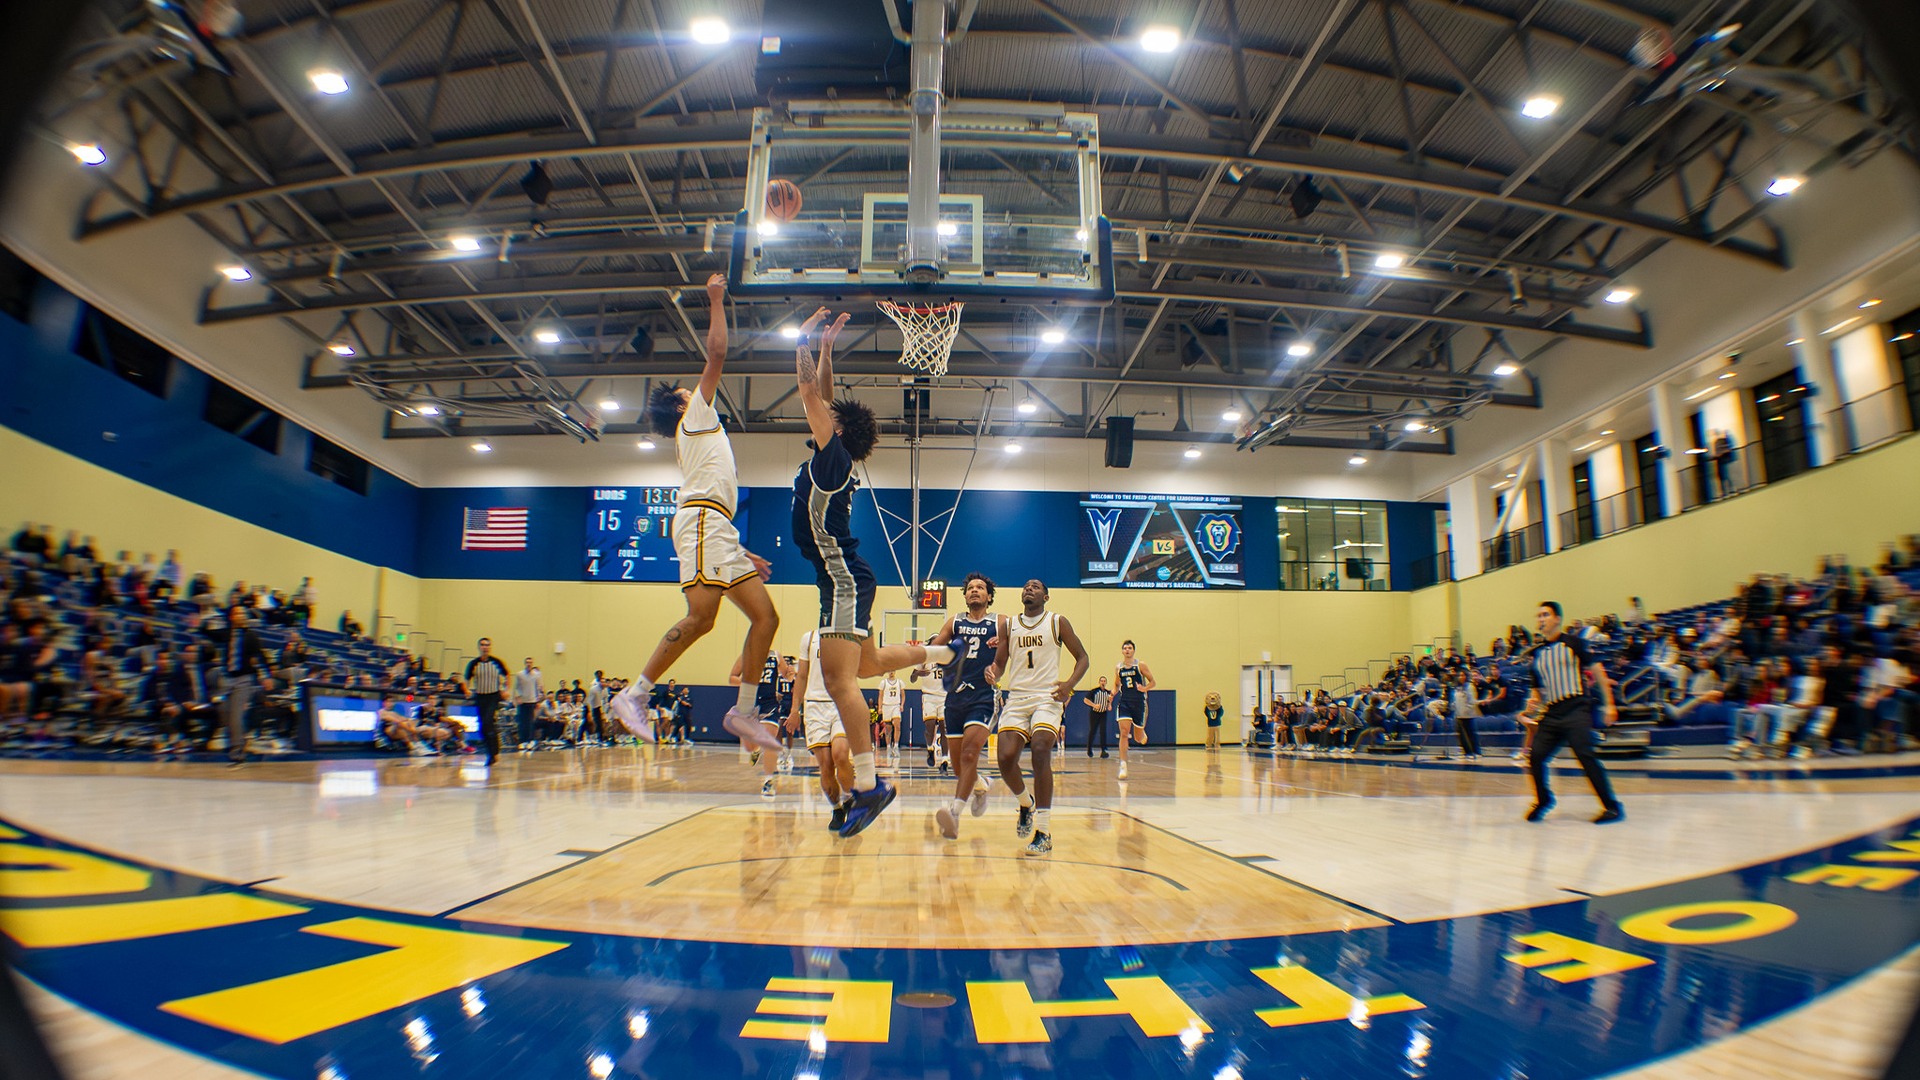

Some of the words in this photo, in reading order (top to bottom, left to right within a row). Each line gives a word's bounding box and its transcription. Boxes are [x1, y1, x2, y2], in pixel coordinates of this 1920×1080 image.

[594, 490, 627, 500] LIONS
[645, 488, 679, 504] 13:0
[648, 506, 676, 515] PERIO
[597, 510, 621, 531] 15
[660, 517, 669, 537] 1
[618, 549, 640, 558] FOULS
[1157, 541, 1172, 552] VS
[587, 559, 600, 576] 4
[621, 559, 635, 579] 2
[923, 581, 944, 590] 13:07
[922, 591, 942, 607] 27
[958, 626, 988, 635] MENLO
[964, 636, 980, 659] 2
[1018, 635, 1043, 648] LIONS
[1026, 650, 1034, 669] 1
[933, 669, 943, 679] 15
[781, 683, 790, 692] 11
[1126, 677, 1134, 688] 2
[0, 823, 571, 1044] LIV
[1503, 900, 1798, 983] OF
[739, 965, 1428, 1043] THE
